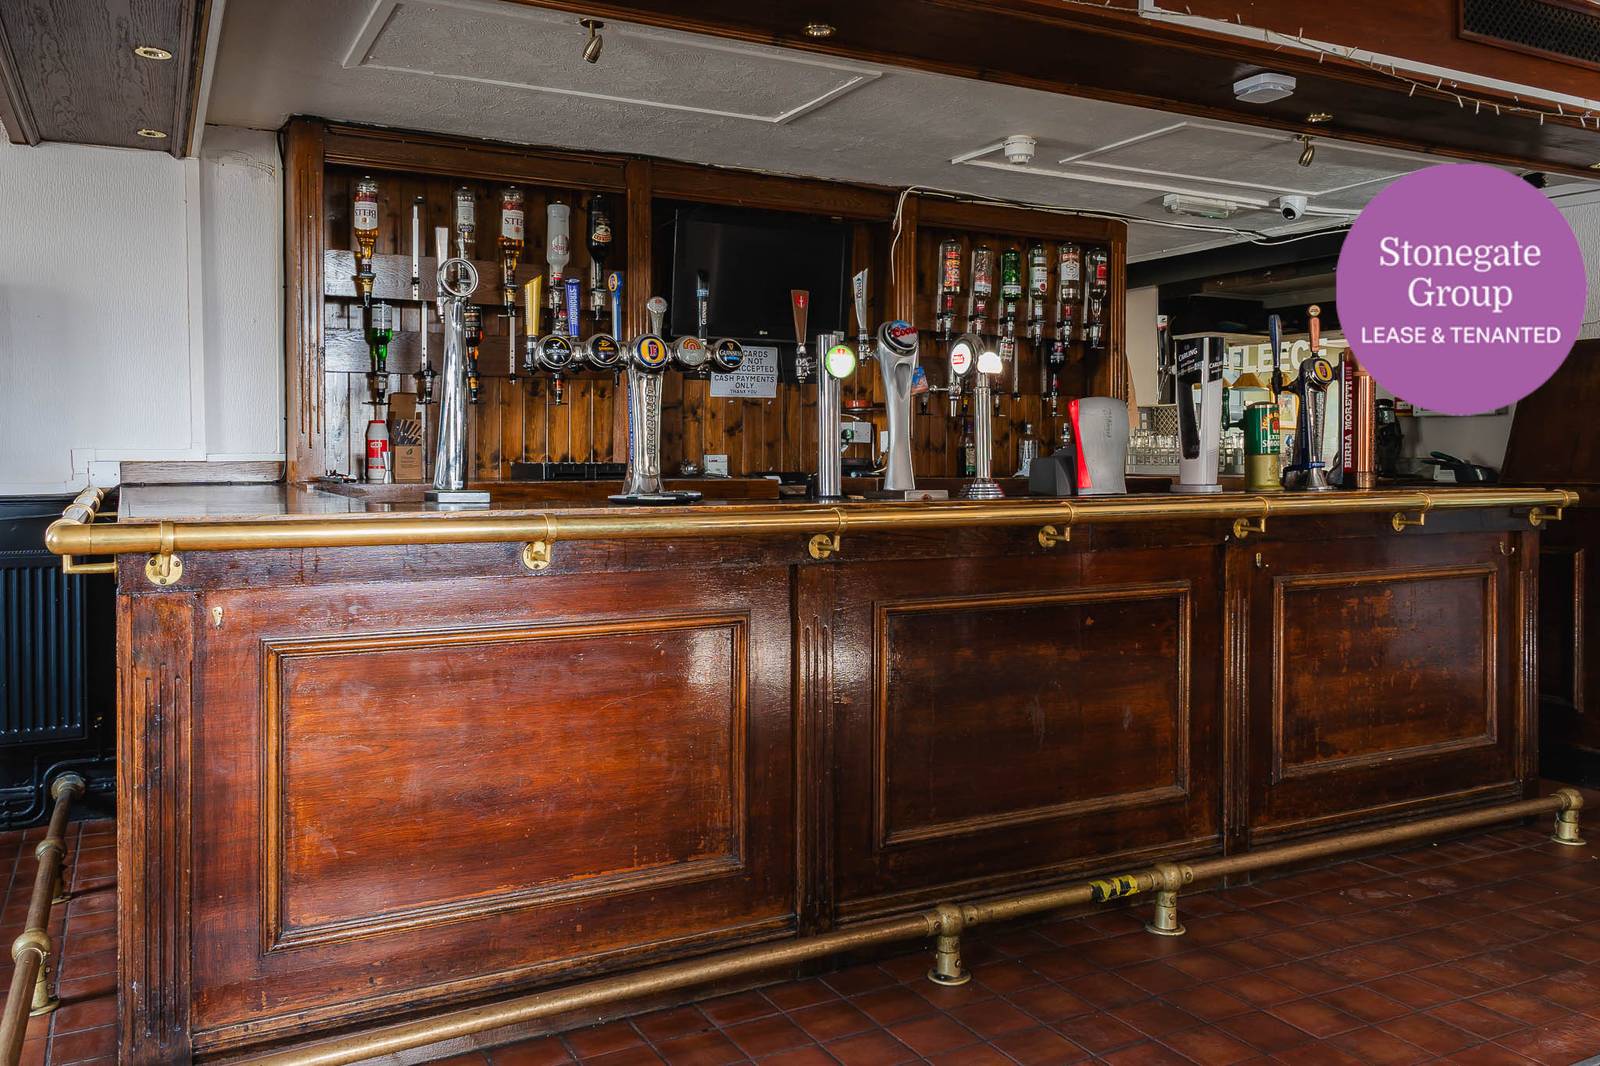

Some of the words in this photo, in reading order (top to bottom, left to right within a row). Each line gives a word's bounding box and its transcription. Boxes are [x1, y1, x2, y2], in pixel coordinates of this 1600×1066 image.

[1178, 347, 1198, 362] CARLING
[1344, 381, 1352, 430] MORETTI
[1344, 433, 1352, 468] BIRRA
